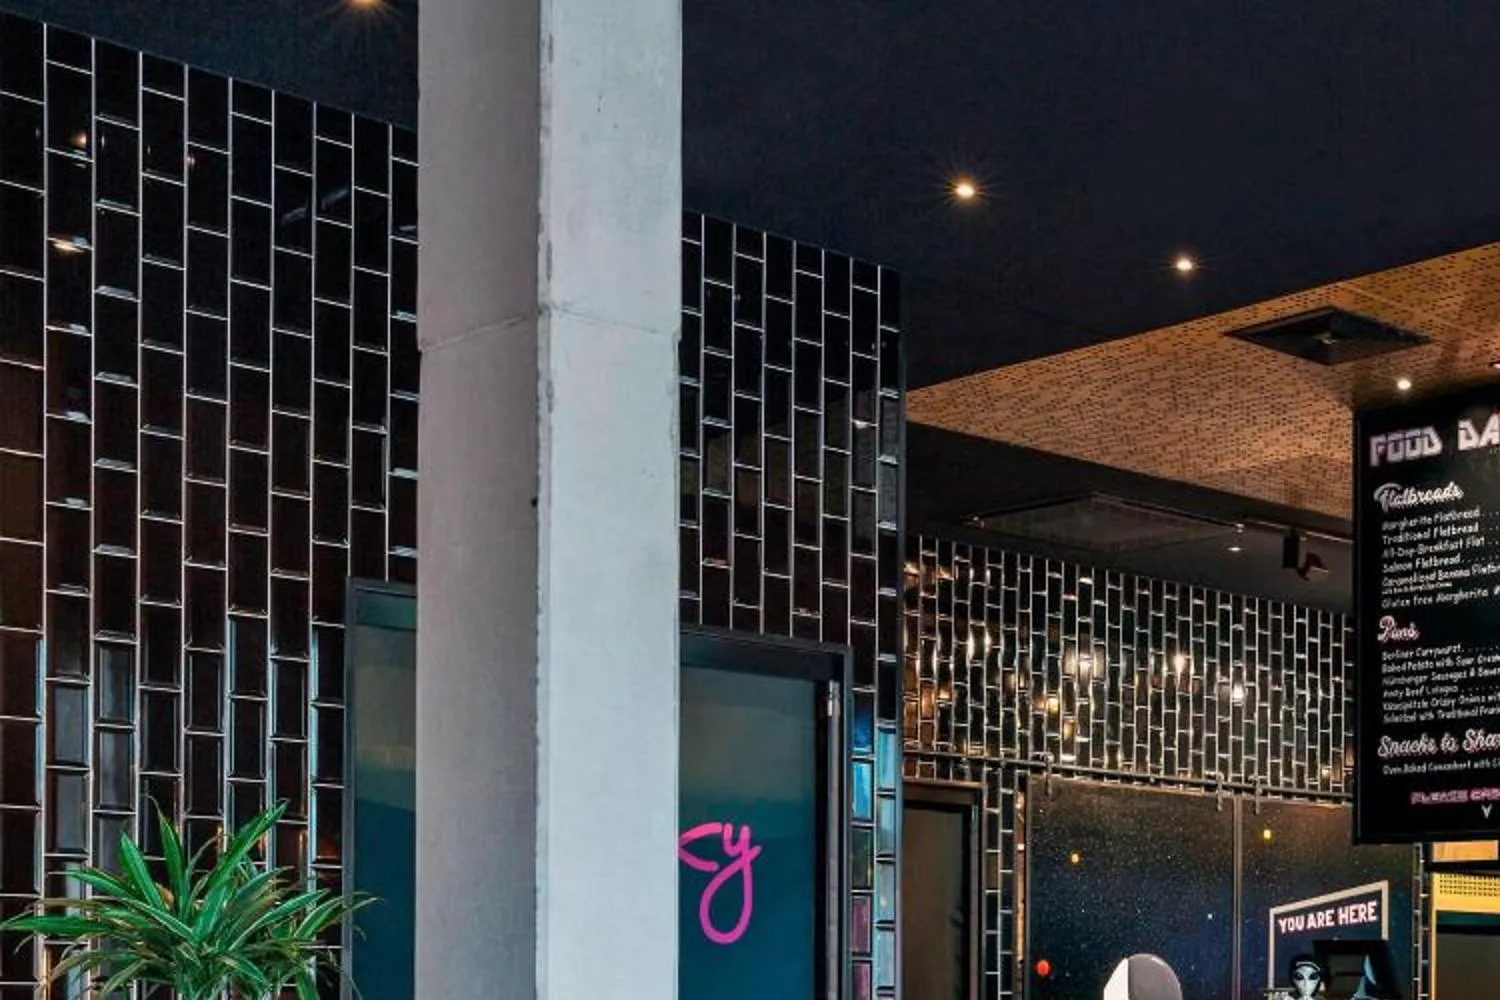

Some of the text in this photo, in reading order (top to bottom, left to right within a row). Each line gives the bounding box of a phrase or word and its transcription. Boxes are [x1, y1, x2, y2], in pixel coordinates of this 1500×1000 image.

[1369, 425, 1443, 467] FOOD
[1373, 481, 1465, 514] Flatbreads
[1433, 521, 1480, 539] Flatbread
[1415, 552, 1461, 570] Flatbread
[1377, 735, 1439, 758] Snacks
[1440, 731, 1460, 754] to
[1277, 900, 1378, 934] YOU ARE HERE
